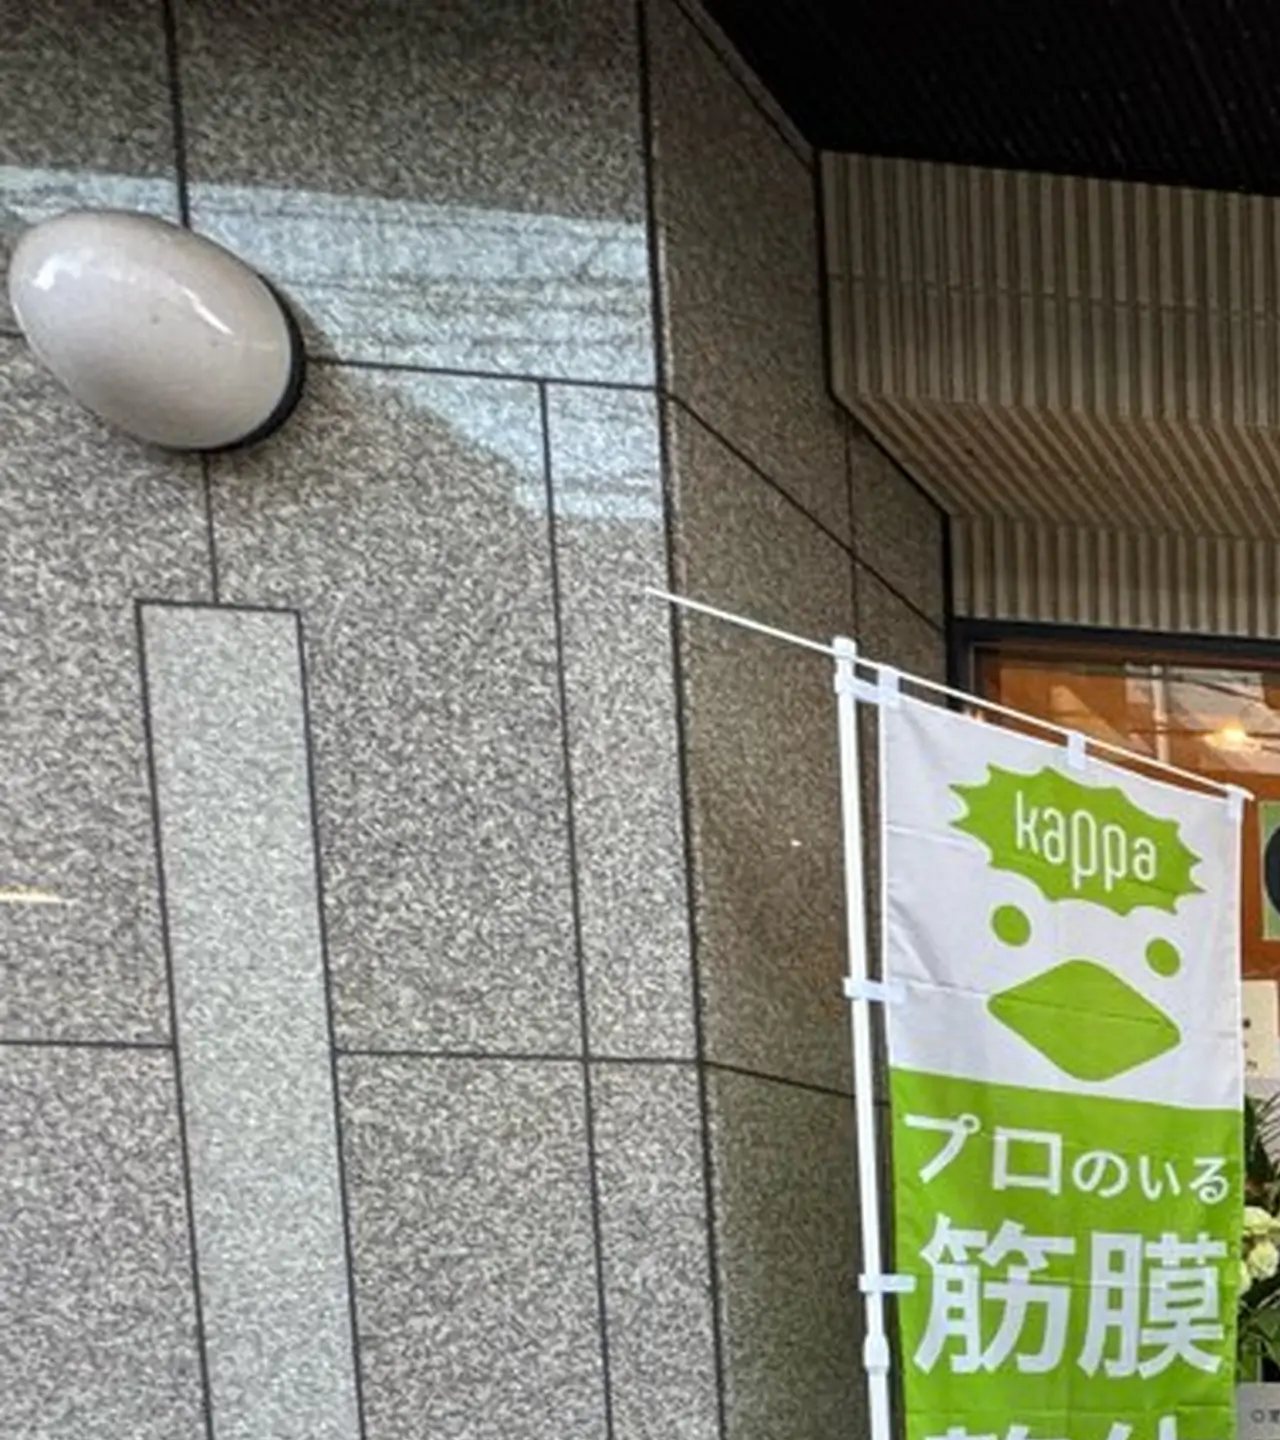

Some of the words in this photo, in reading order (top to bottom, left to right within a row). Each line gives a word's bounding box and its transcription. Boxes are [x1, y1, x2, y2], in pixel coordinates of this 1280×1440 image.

[1015, 789, 1158, 892] kappa
[904, 1114, 1229, 1203] プロのいる
[914, 1213, 1226, 1378] 筋膜
